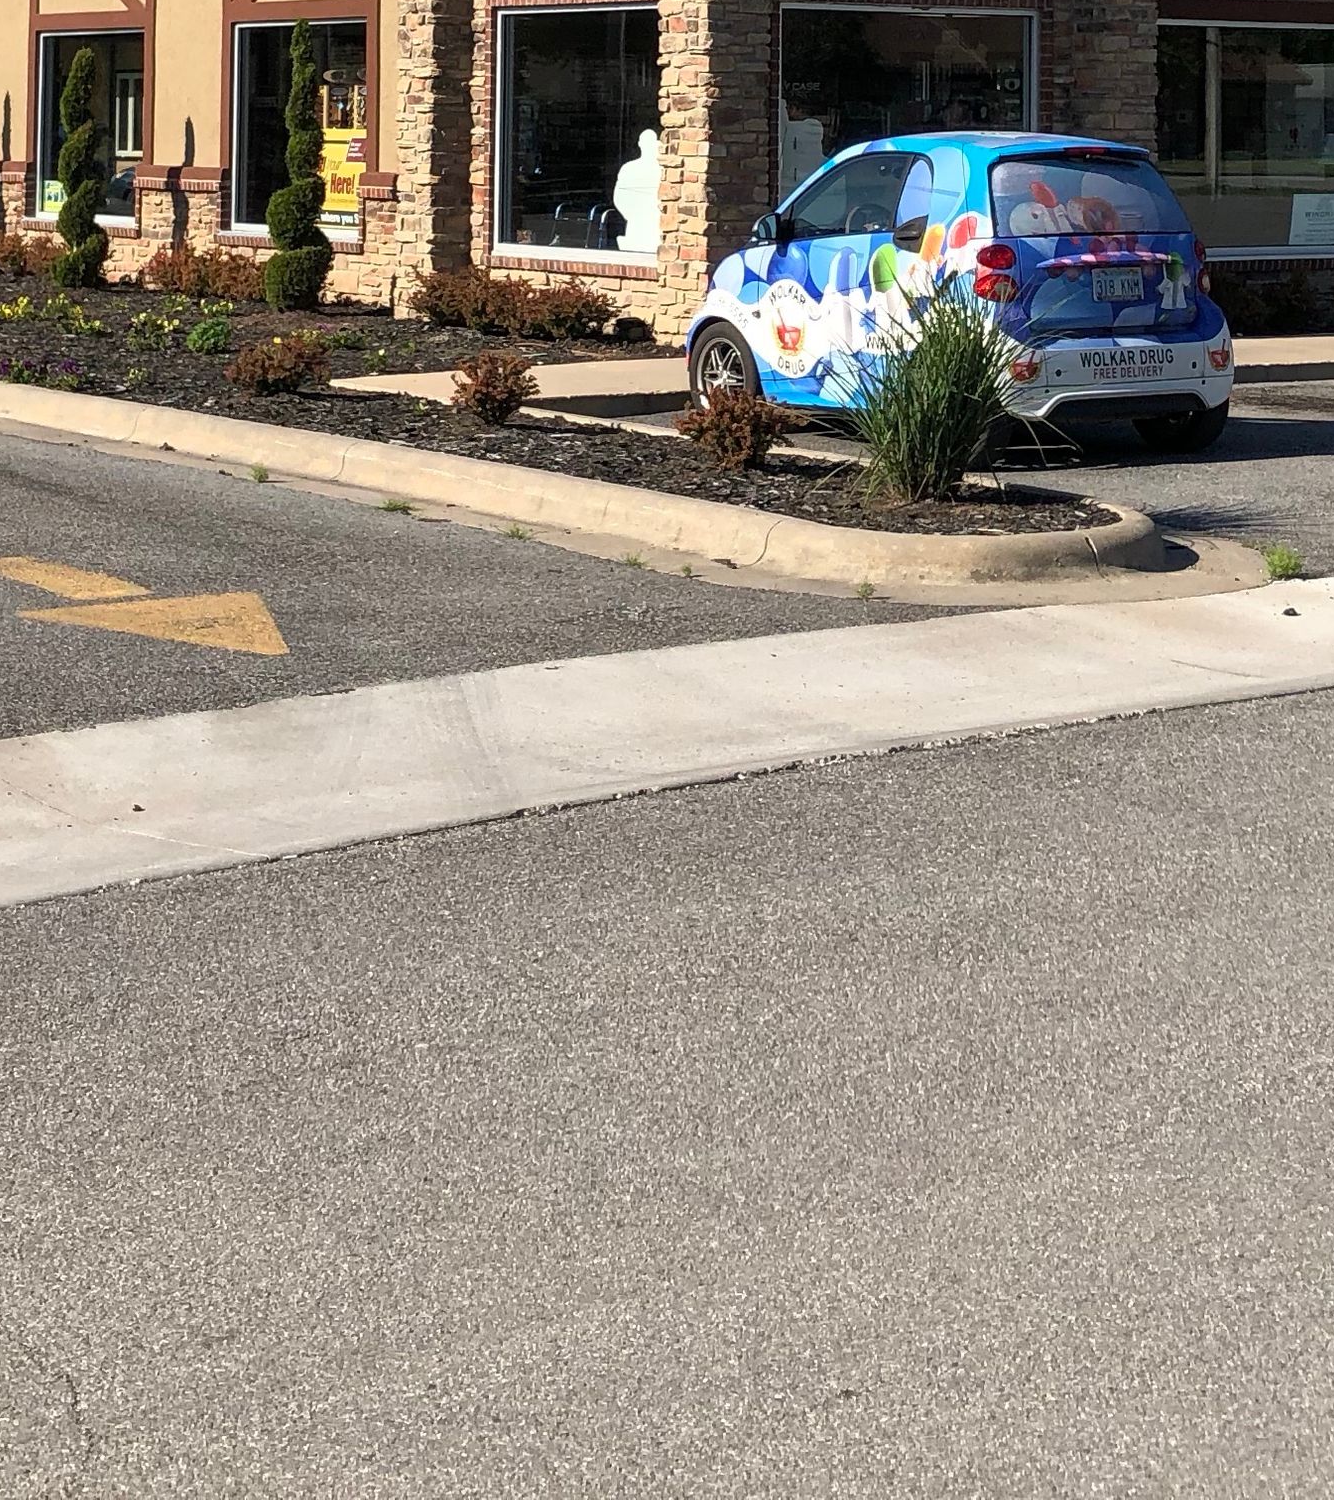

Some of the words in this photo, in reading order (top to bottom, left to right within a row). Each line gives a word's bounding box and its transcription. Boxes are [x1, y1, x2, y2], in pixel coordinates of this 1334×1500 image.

[330, 172, 356, 195] Here!
[769, 285, 806, 306] WOLKAR
[1096, 279, 1116, 296] 318
[777, 356, 806, 375] DRUG
[1080, 349, 1136, 368] WOLKAR
[1139, 348, 1174, 365] DRUG
[1093, 367, 1117, 379] FREE
[1120, 365, 1164, 378] DELIVERY
